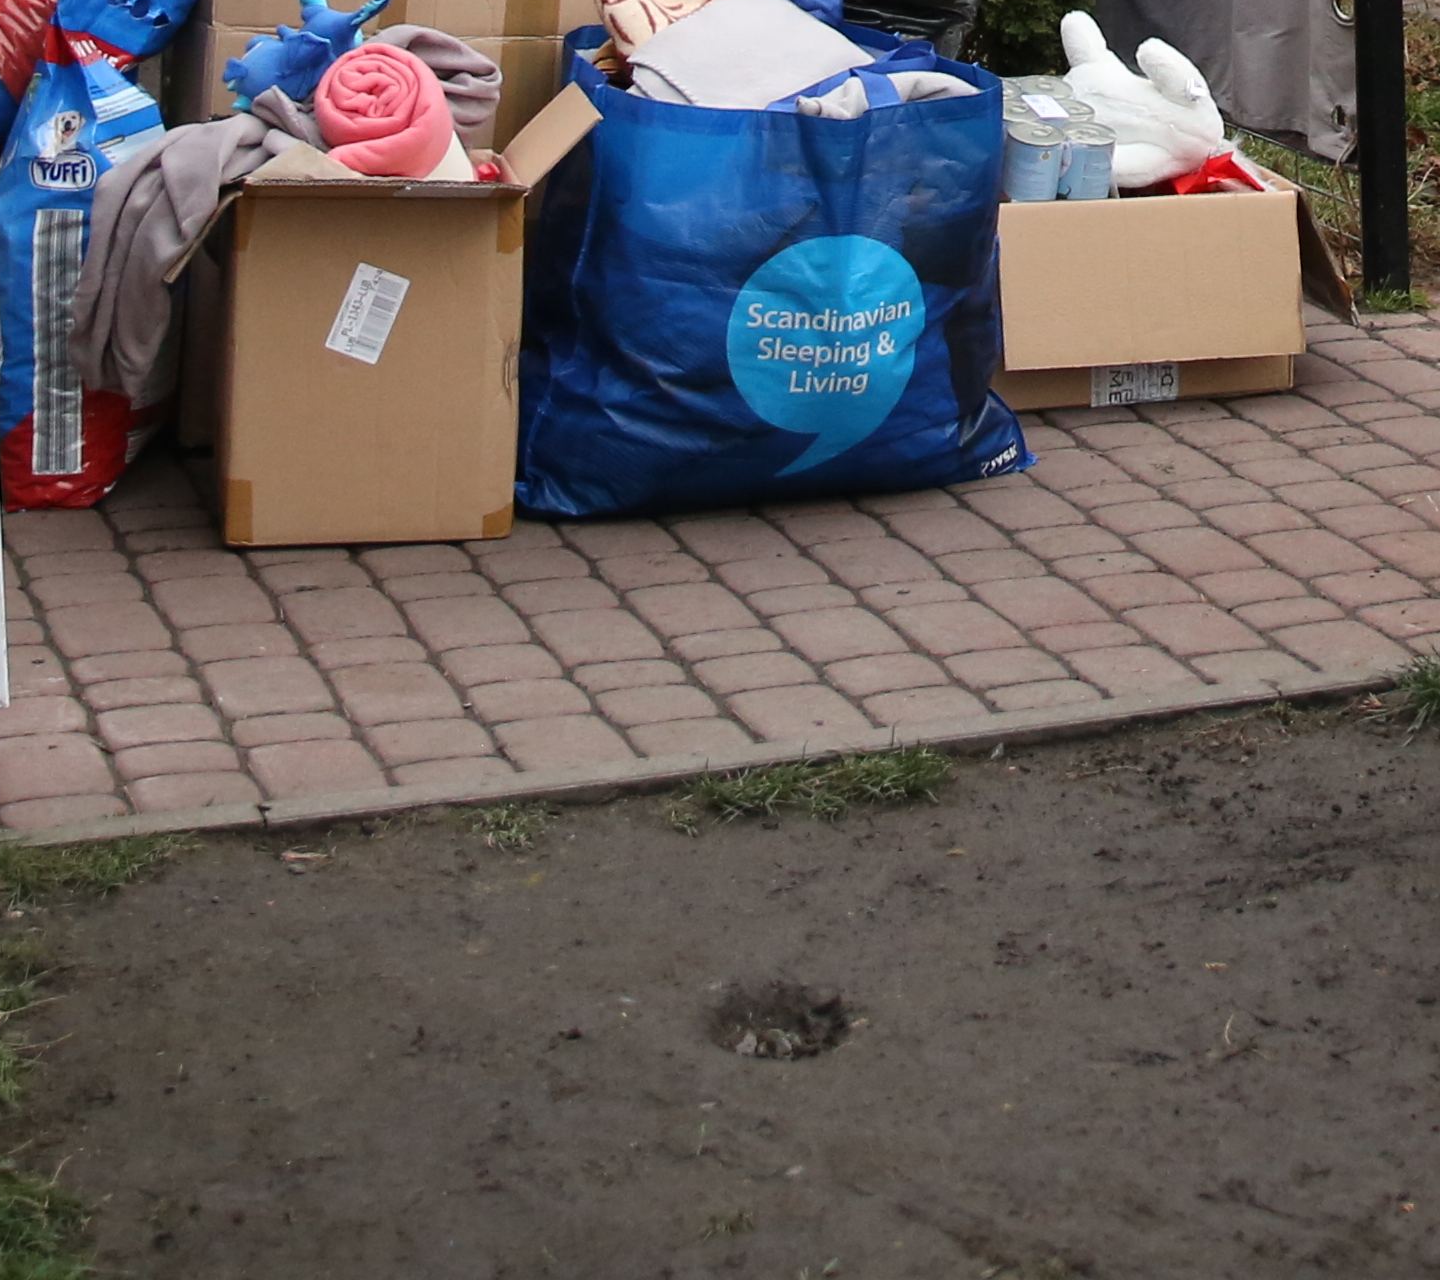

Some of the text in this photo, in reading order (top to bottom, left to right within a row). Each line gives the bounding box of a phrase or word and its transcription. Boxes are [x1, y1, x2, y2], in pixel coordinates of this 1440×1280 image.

[746, 300, 912, 333] Scandinavian
[757, 331, 896, 368] Sleeping &
[789, 370, 870, 396] Living
